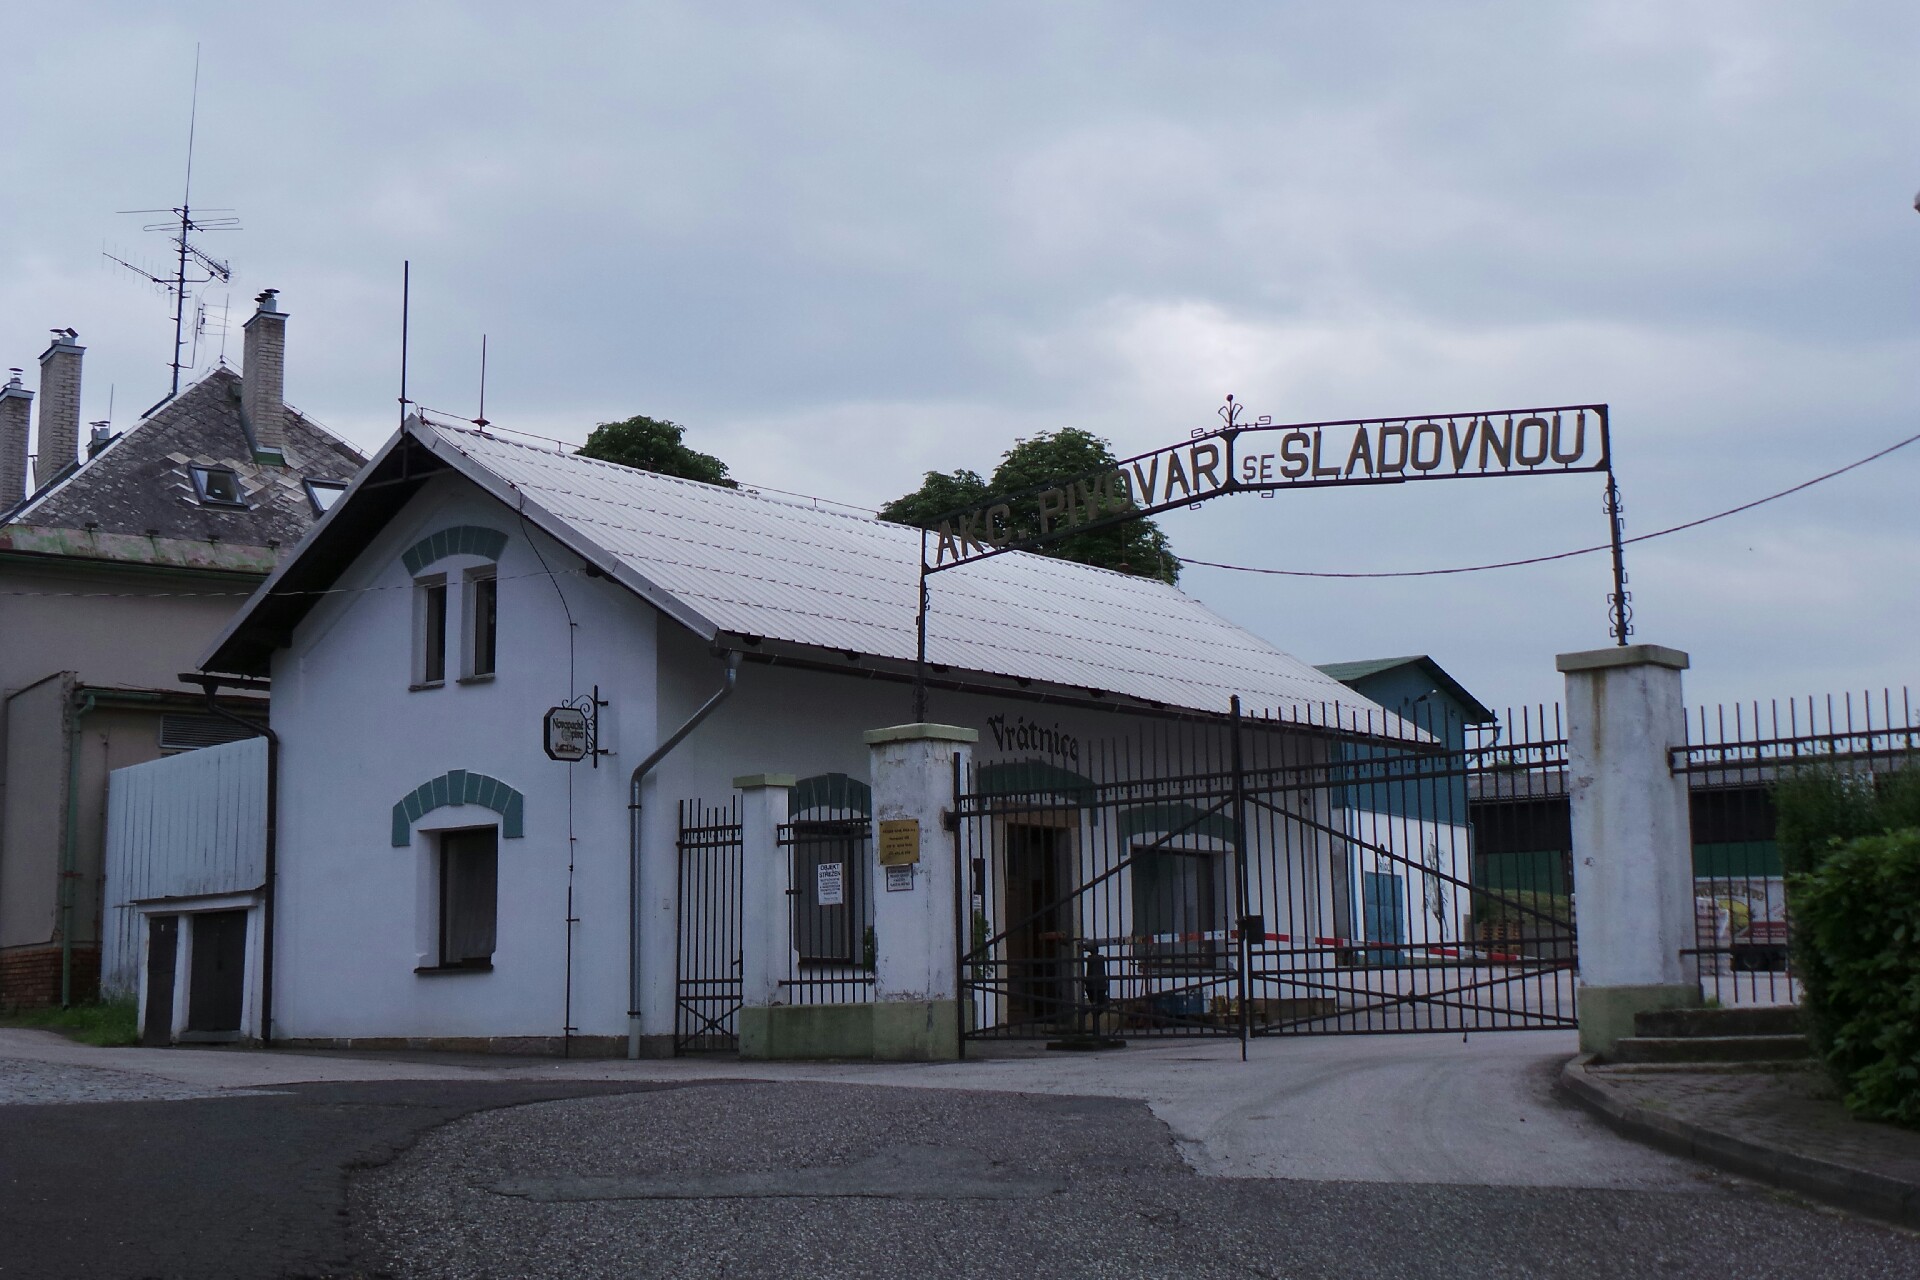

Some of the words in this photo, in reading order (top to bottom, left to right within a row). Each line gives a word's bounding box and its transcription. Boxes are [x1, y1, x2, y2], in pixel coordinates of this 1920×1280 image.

[936, 502, 1028, 565] AKC.
[1038, 443, 1220, 534] PIVOVAR
[1243, 454, 1275, 480] SE
[1280, 412, 1586, 479] SLADOVNOU
[987, 712, 1080, 761] Vrátnice
